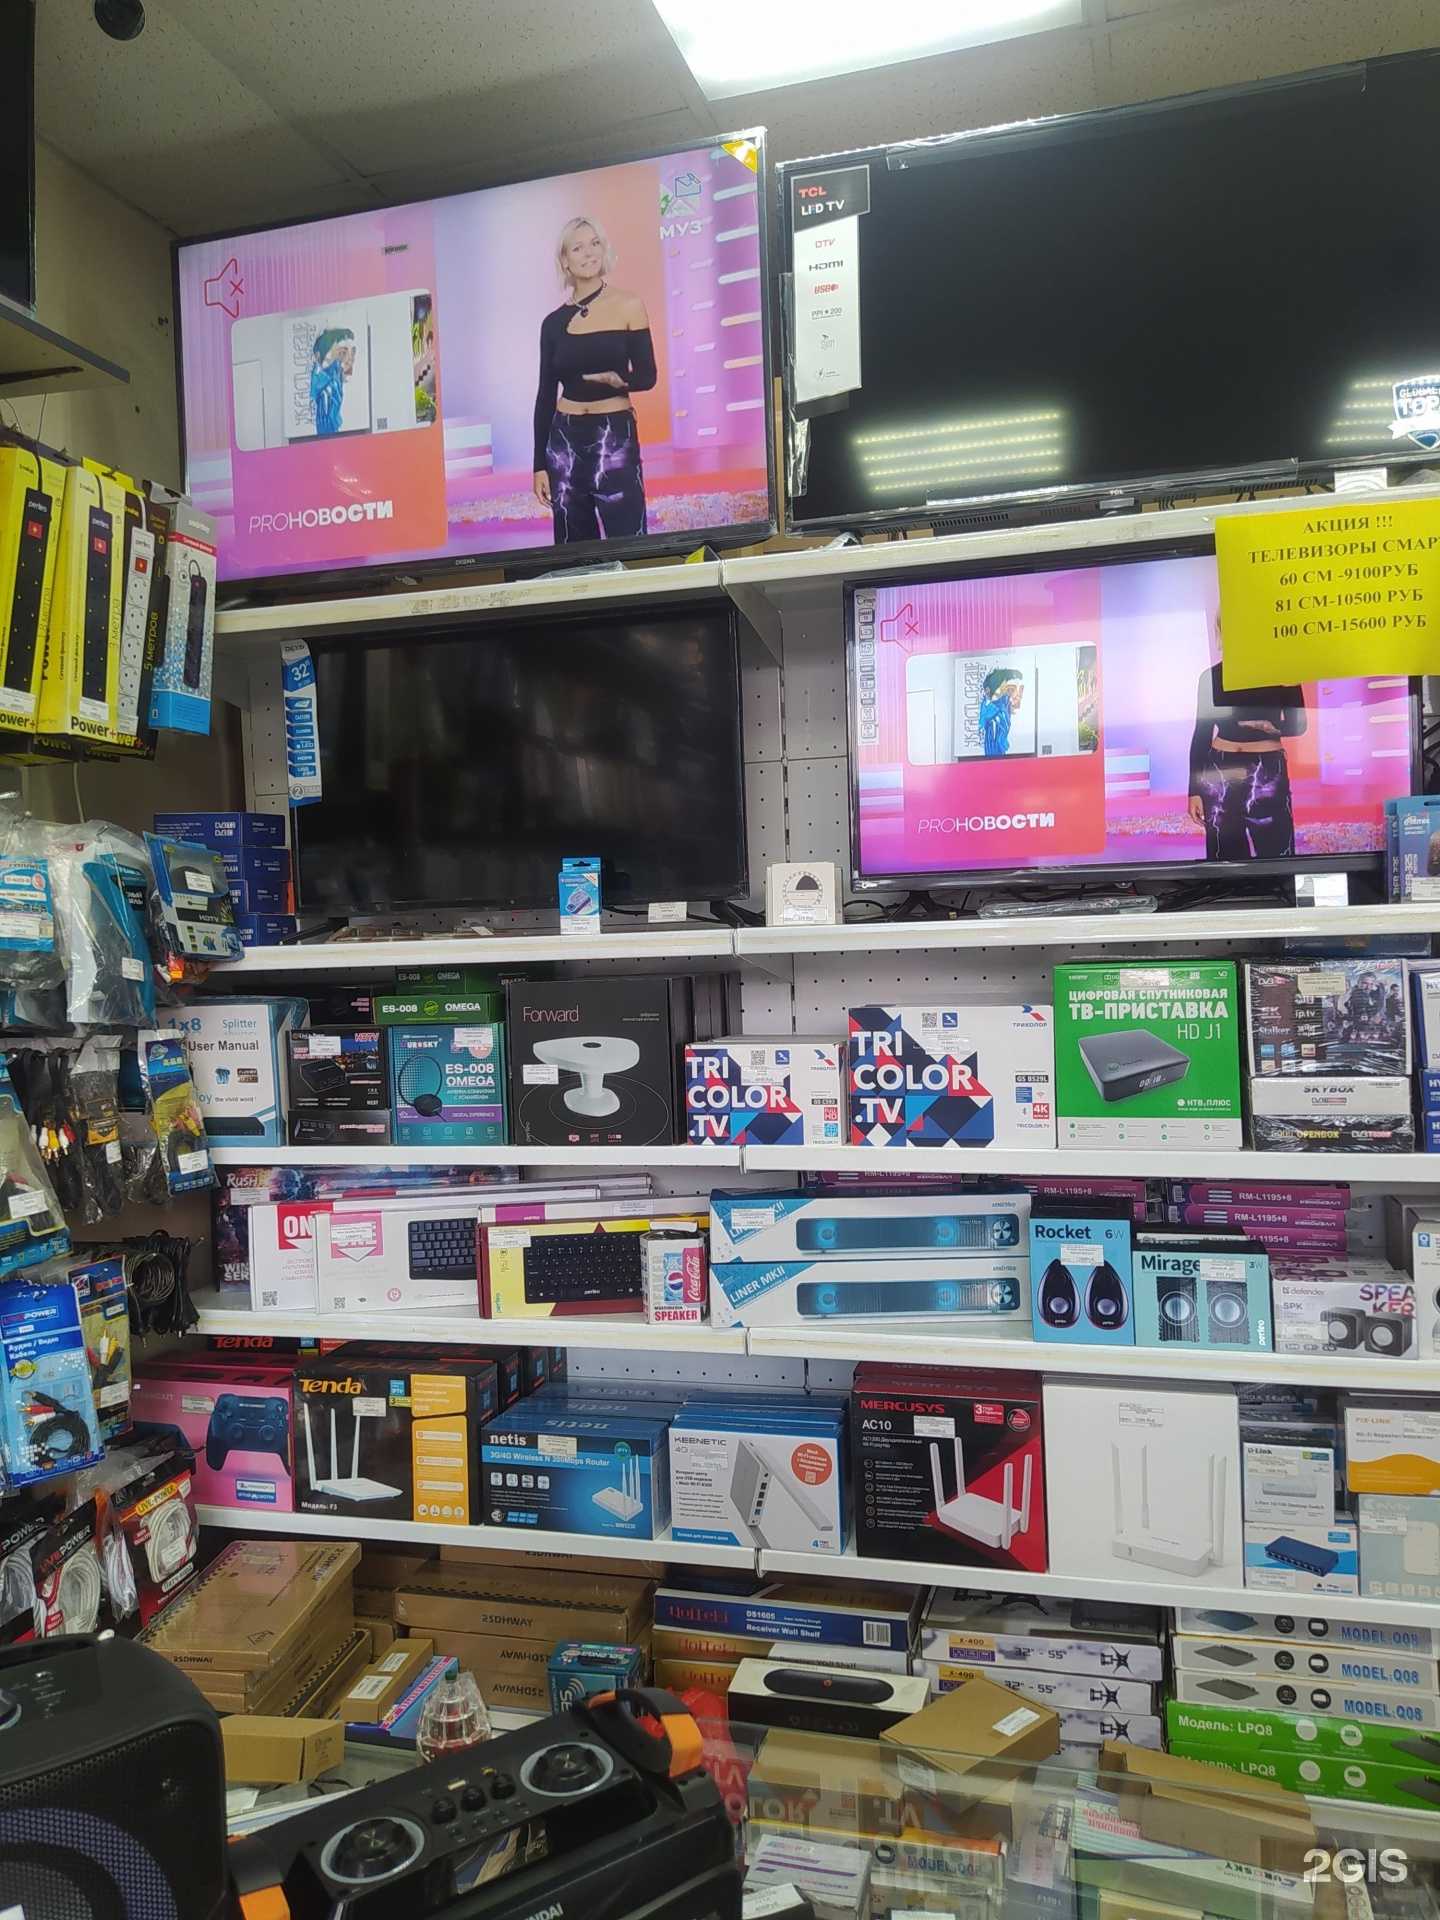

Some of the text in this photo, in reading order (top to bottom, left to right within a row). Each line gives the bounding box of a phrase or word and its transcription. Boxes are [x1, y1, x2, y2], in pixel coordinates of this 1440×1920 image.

[799, 186, 827, 198] TCL
[825, 199, 845, 212] TV
[660, 219, 702, 240] МУЗ
[815, 238, 836, 249] DTV
[808, 259, 844, 272] HDMI
[1303, 515, 1393, 534] АКЦИЯ !!!
[1248, 536, 1440, 565] ТЕЛЕВИЗОРЫ СМАР
[1279, 573, 1297, 587] 60
[1303, 570, 1333, 585] СМ
[1275, 588, 1424, 613] 81 СМ-10500 РУБ
[1273, 614, 1427, 639] 100 СМ-15600 РУБ
[0, 712, 37, 729] ower+
[71, 715, 117, 738] Power+
[1069, 988, 1228, 1002] ЦИФРОВАЯ СПУТНИКОВАЯ
[382, 1002, 481, 1014] ES-008 OMEGA
[523, 1005, 580, 1023] Forward
[1068, 1001, 1229, 1020] ТВ-ПРИСТАВКА
[168, 1017, 257, 1034] 1x8 Splitter
[1177, 1023, 1221, 1040] HD J1
[187, 1039, 260, 1052] User Manual
[851, 1030, 903, 1057] TRI
[445, 1063, 495, 1075] ES-008
[686, 1056, 729, 1079] TRI
[446, 1076, 495, 1088] OMEGA
[854, 1063, 974, 1091] COLOR
[687, 1085, 788, 1109] COLOR
[855, 1097, 906, 1124] .TV
[1033, 1103, 1049, 1113] 4K
[689, 1115, 729, 1137] .TV
[1034, 1223, 1092, 1241] Rocket
[1140, 1254, 1201, 1276] Mirage
[729, 1265, 786, 1303] LINER MKII
[1290, 1287, 1326, 1297] defender
[1358, 1284, 1416, 1301] SPEA
[1282, 1301, 1304, 1311] SPK
[654, 1310, 698, 1322] SPEAKER
[300, 1376, 362, 1395] Tenda
[860, 1400, 945, 1414] MERCUSYS
[975, 1403, 982, 1415] 3
[862, 1419, 893, 1431] AC10
[489, 1433, 528, 1447] netis
[673, 1436, 727, 1447] KEENETIC
[746, 1623, 821, 1639] Receiver Wall Shelf
[1178, 1714, 1274, 1736] Модель: LPQ8
[1240, 1761, 1277, 1778] LPQ8
